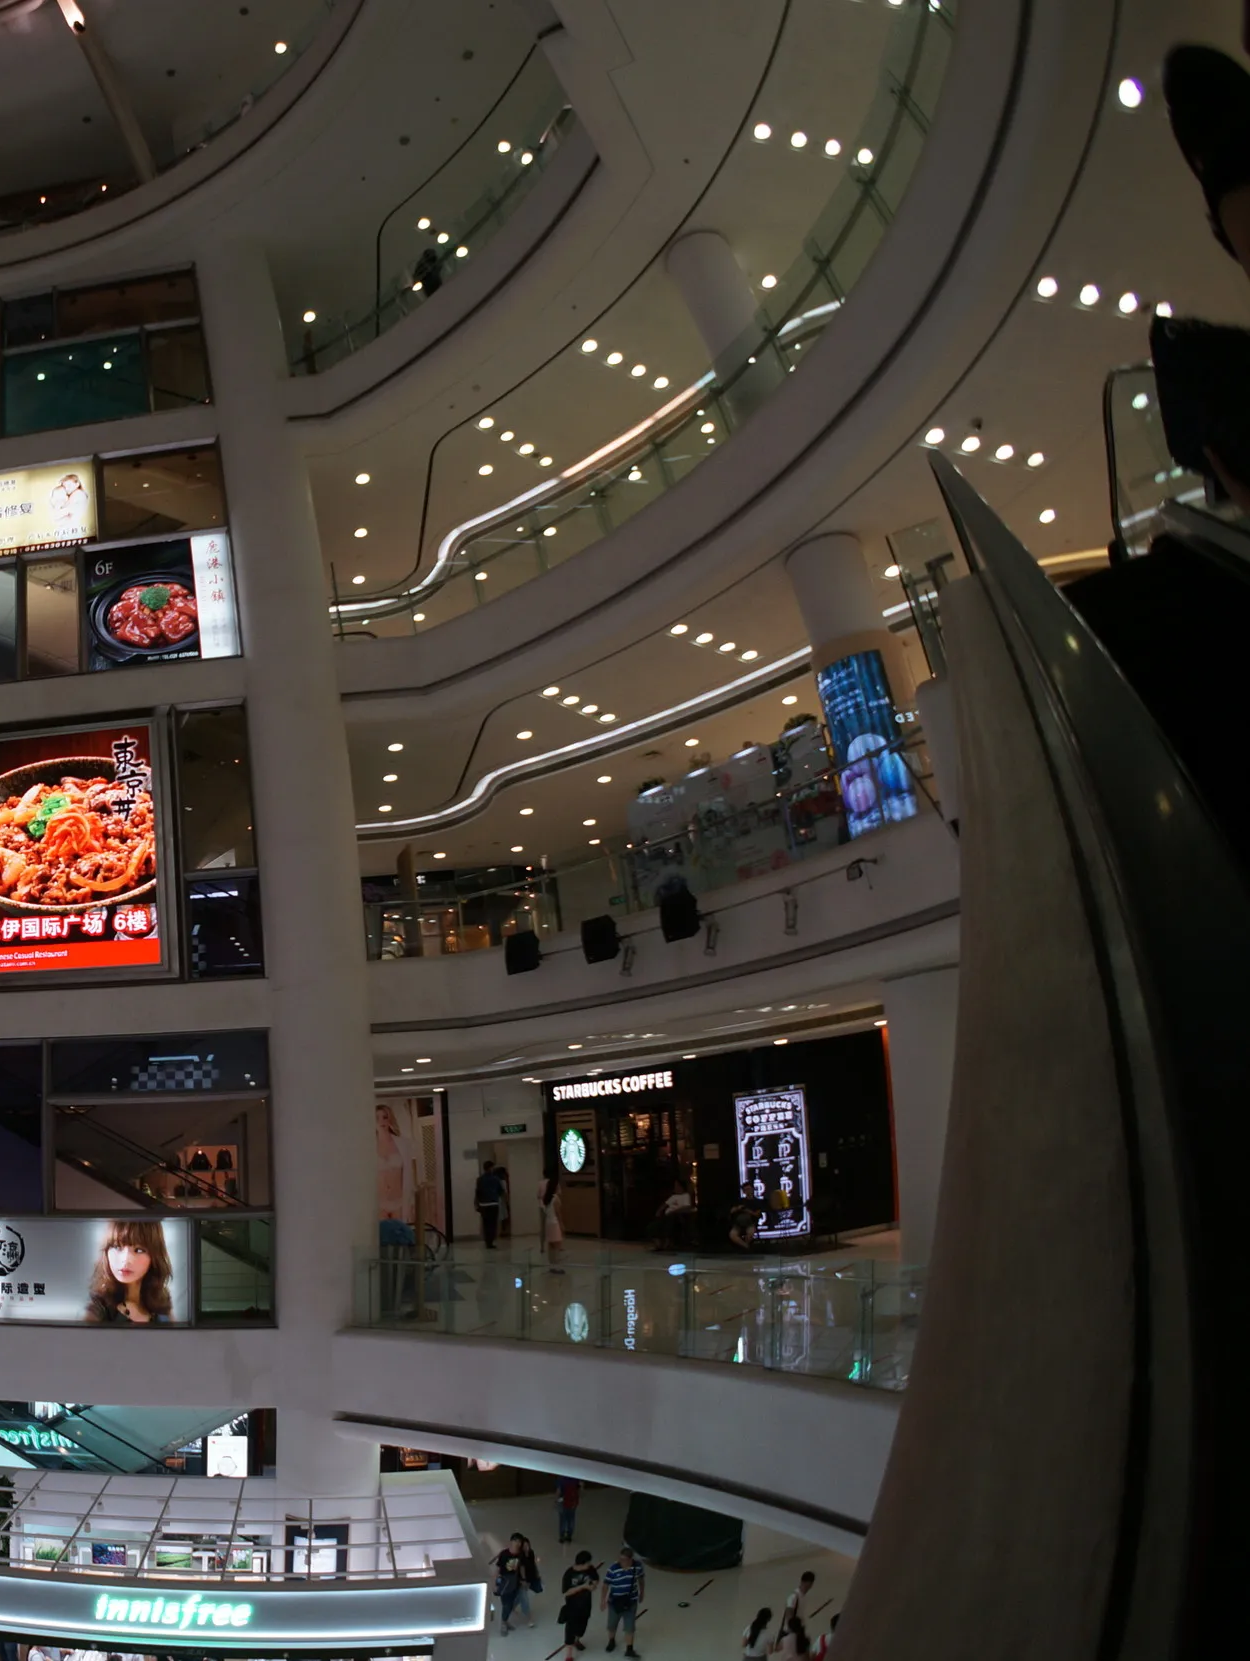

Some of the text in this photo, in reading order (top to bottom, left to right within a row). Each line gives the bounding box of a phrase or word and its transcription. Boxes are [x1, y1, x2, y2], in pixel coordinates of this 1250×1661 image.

[95, 560, 113, 575] 6F
[114, 909, 148, 931] 6楼
[13, 951, 34, 960] Casual
[35, 950, 68, 959] Restaurant
[553, 1071, 673, 1101] STARBUCKS COFFEE
[745, 1101, 792, 1115] STARBUCKS
[745, 1111, 793, 1125] COFFEE
[95, 1594, 253, 1630] innisfree
